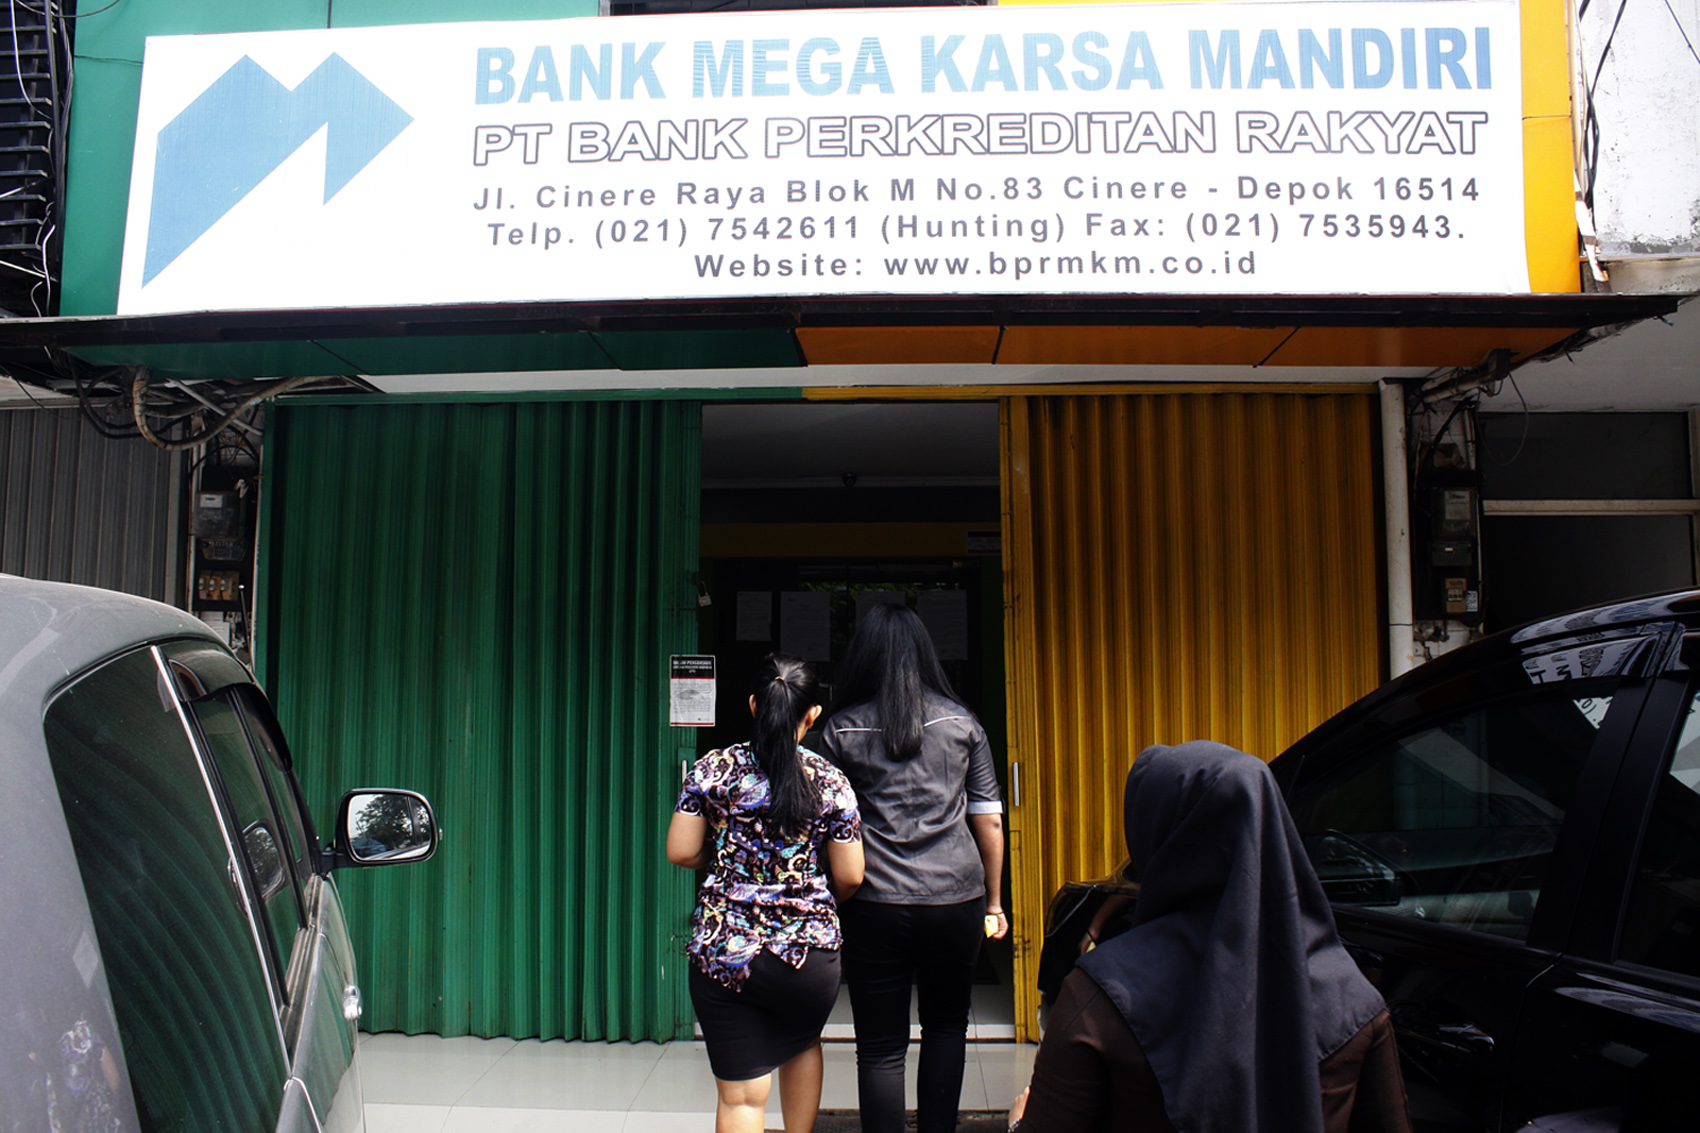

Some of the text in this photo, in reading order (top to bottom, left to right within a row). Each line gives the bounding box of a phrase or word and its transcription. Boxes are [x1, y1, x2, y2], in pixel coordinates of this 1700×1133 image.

[476, 27, 1491, 104] BANK MEGA KARSA MANDIRI
[473, 111, 1488, 166] PT BANK PERKREDITAN RAKYAT
[474, 188, 514, 210] Jl.
[537, 186, 655, 208] Cinere
[678, 183, 764, 210] Raya
[787, 180, 868, 202] Blok
[891, 179, 913, 201] M
[937, 177, 1042, 200] No.83
[1064, 176, 1186, 199] Cinere
[1238, 176, 1352, 205] Depok
[1374, 177, 1479, 201] 16514
[488, 213, 1463, 250] Telp. (021) 7542611 (Hunting) Fax: (021) 7535943.
[695, 251, 1255, 280] Website: www.bprmkm.co.id
